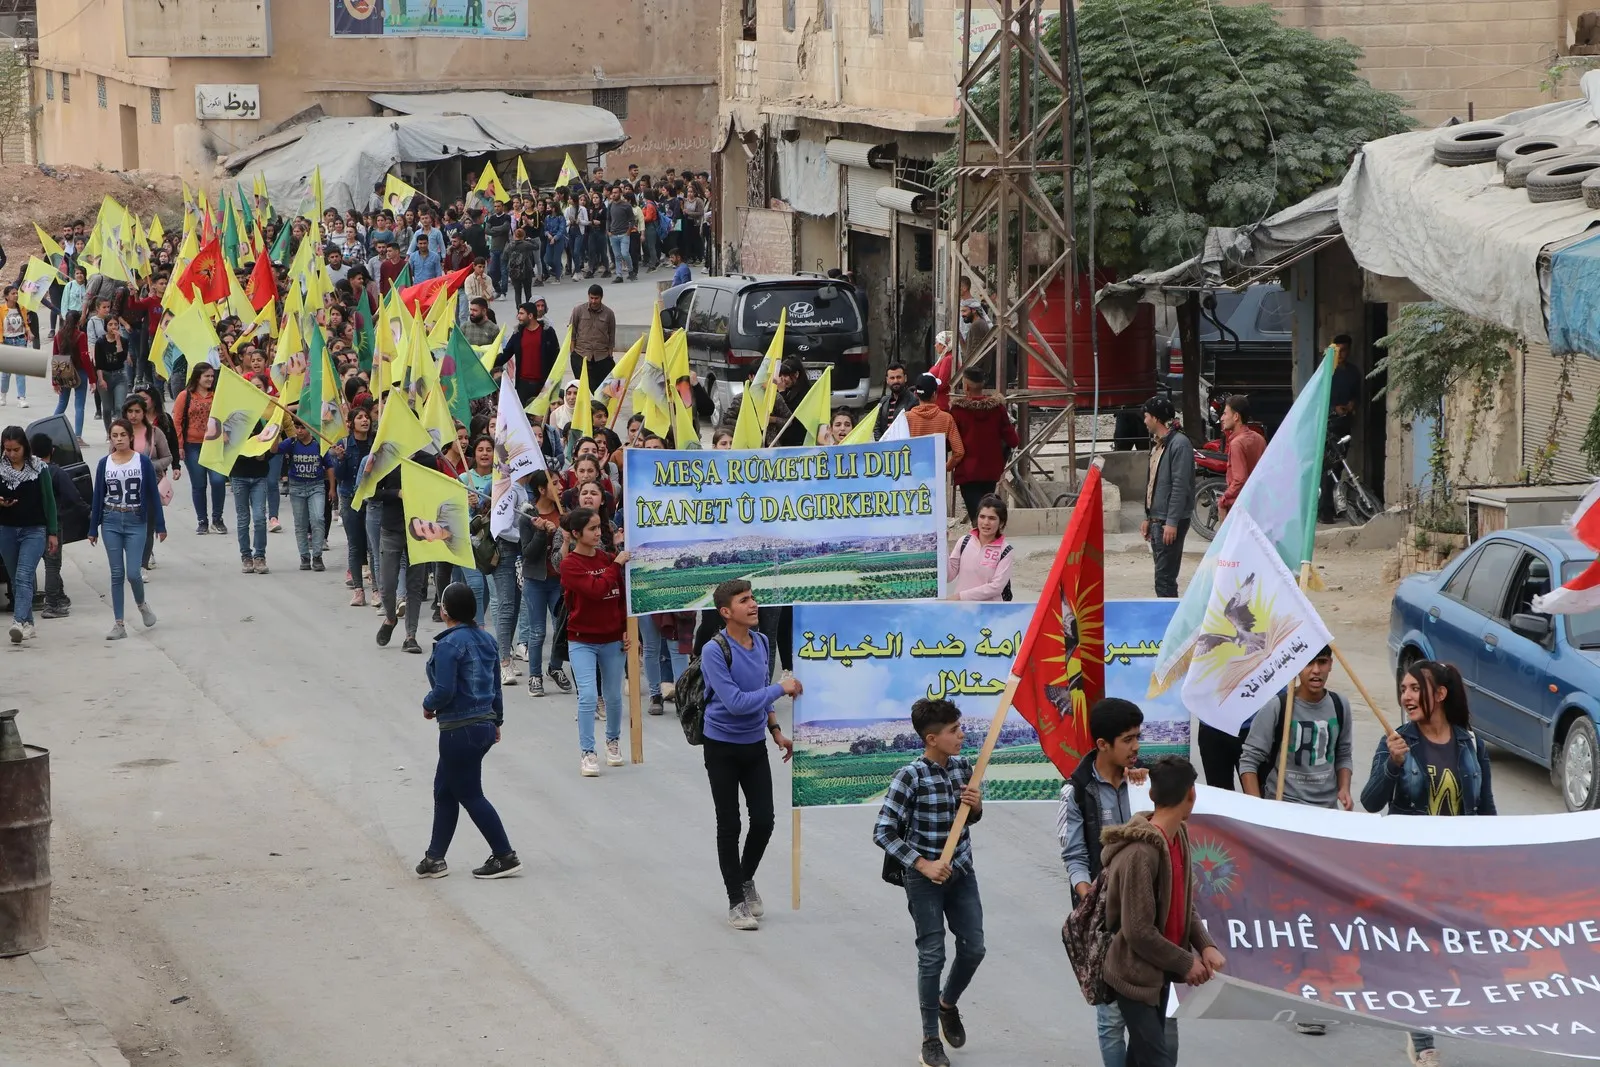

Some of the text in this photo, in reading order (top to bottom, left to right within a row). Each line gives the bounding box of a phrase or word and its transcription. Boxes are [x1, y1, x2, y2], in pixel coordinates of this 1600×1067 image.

[293, 454, 319, 463] BREAK
[653, 444, 913, 492] MEŞA RÛMETÊ LI DIJÎ
[105, 470, 118, 478] EW
[106, 477, 141, 504] 98
[636, 483, 933, 528] ÎXANET Û DAGIRKERIYÊ
[984, 548, 999, 561] 52
[798, 630, 903, 668] الخيانة
[909, 633, 965, 659] ضد
[1104, 638, 1164, 666] سير
[1228, 913, 1318, 949] RIHÊ
[1331, 916, 1430, 952] VÎNA
[1336, 987, 1472, 1014] TEQEZ
